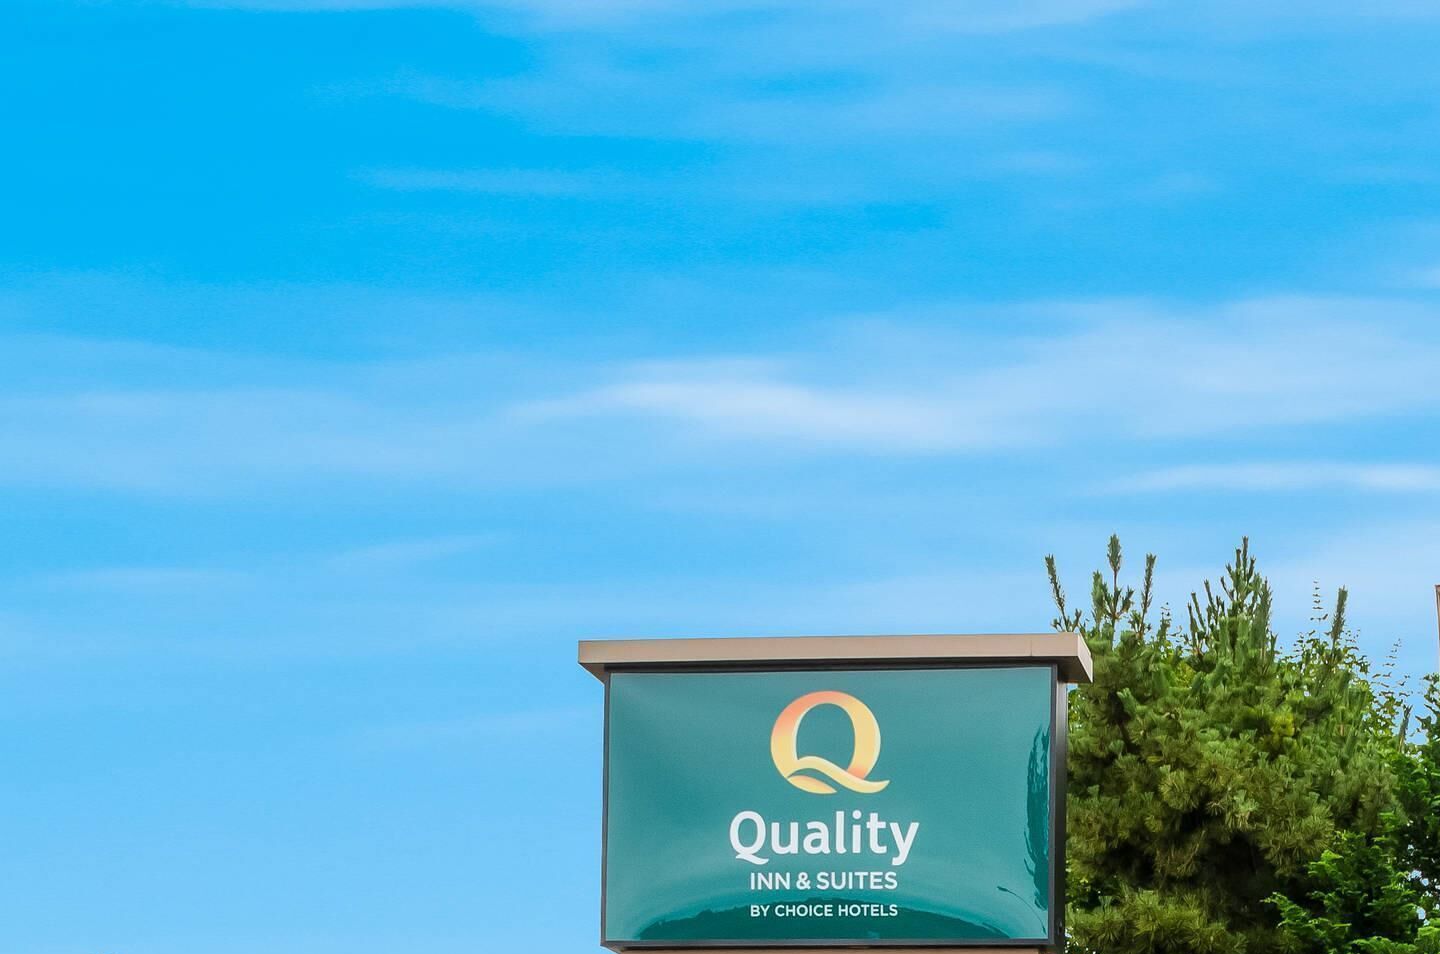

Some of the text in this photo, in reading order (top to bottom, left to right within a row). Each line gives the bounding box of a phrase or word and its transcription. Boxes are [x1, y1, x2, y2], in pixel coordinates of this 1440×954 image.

[729, 809, 920, 866] Quality
[750, 871, 898, 890] INN & SUITES
[750, 904, 898, 917] BY CHOICE HOTELS
